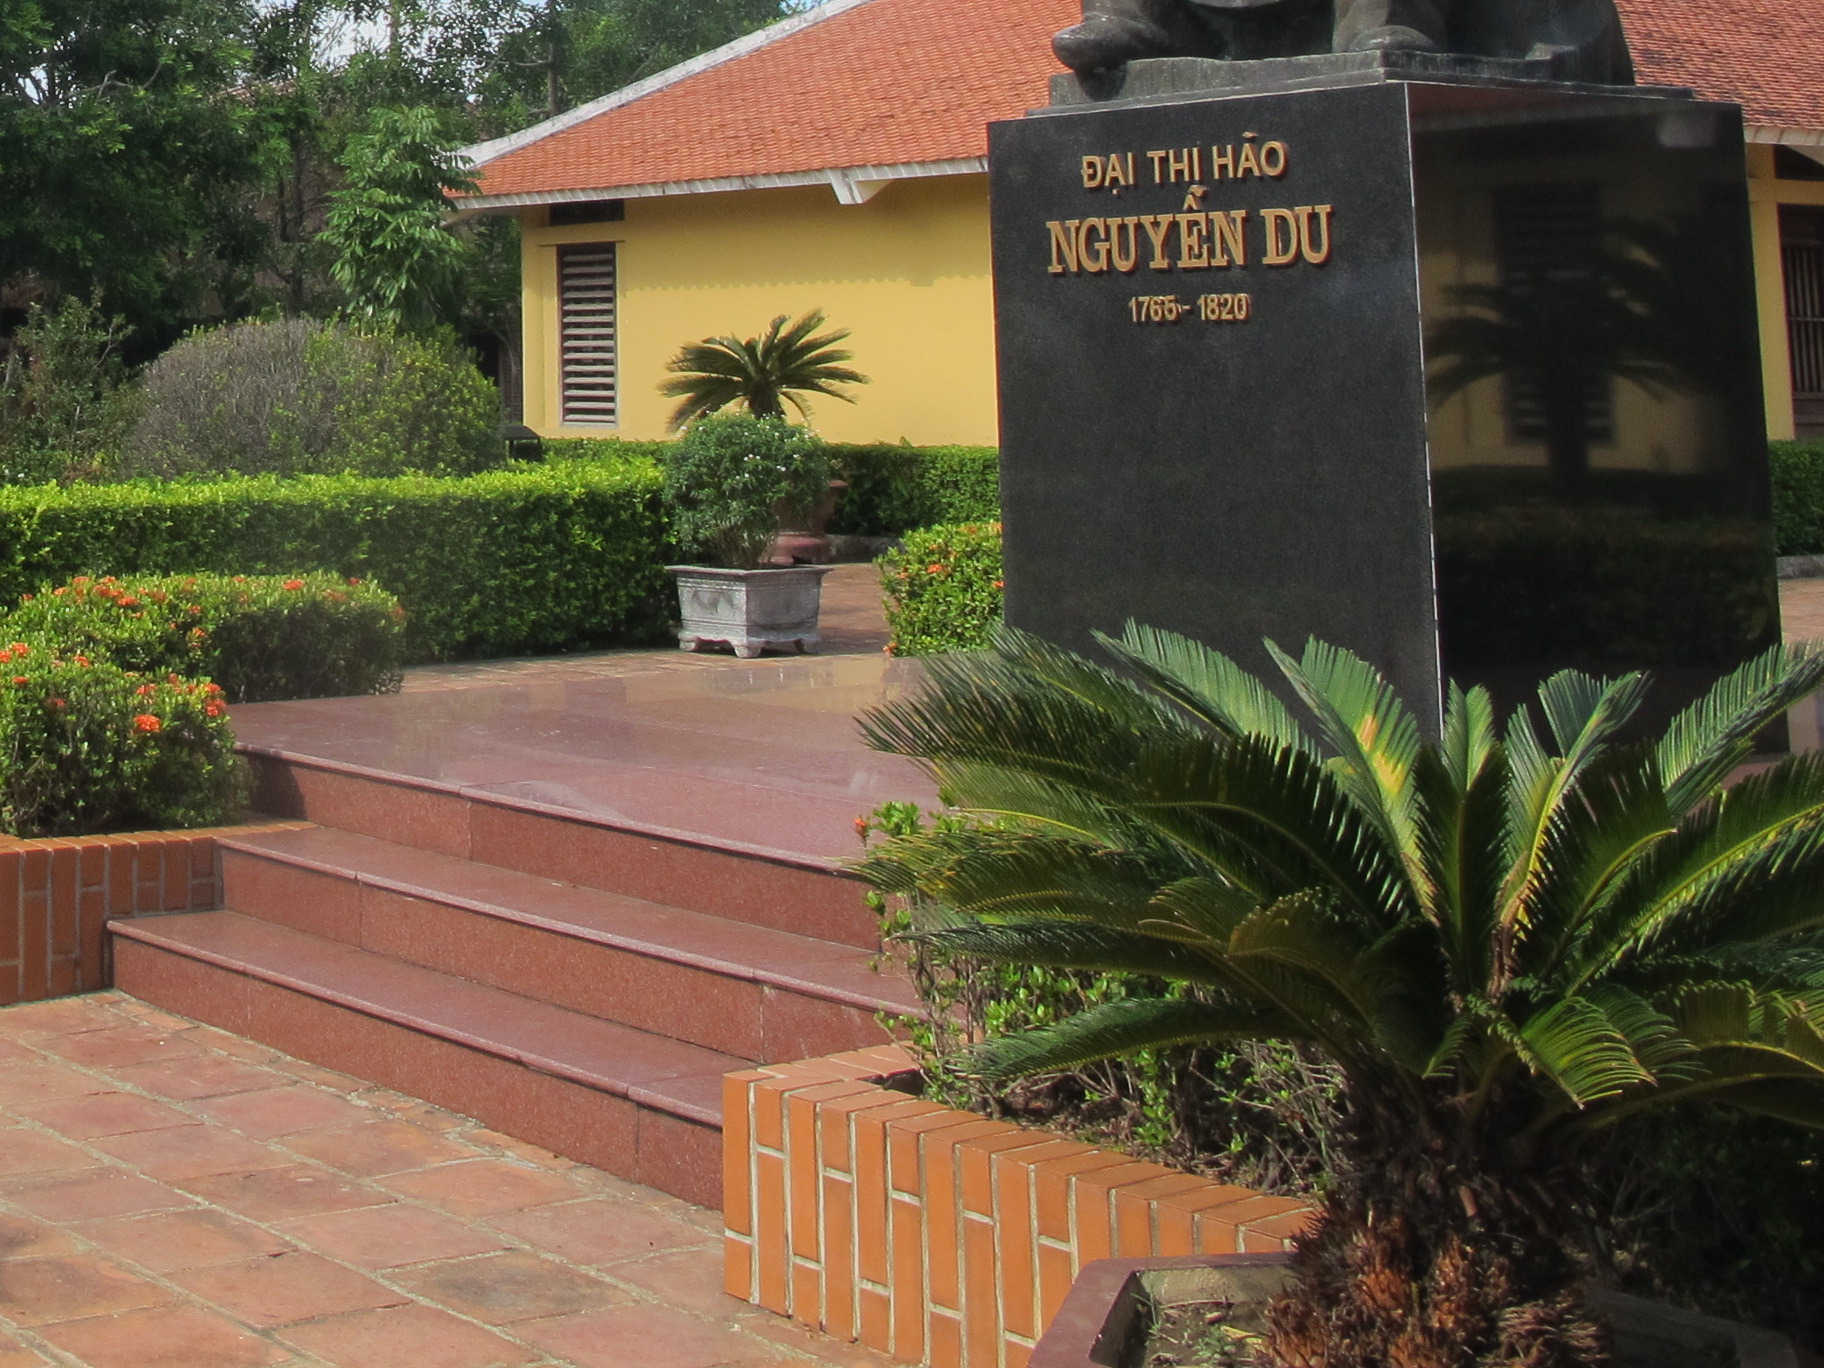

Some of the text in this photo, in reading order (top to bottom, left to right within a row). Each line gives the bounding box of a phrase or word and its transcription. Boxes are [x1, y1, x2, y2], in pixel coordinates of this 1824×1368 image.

[1080, 151, 1138, 195] ĐẠI
[1146, 147, 1201, 183] THI
[1045, 184, 1333, 273] NGUYỄN DU
[1196, 293, 1252, 320] 1820
